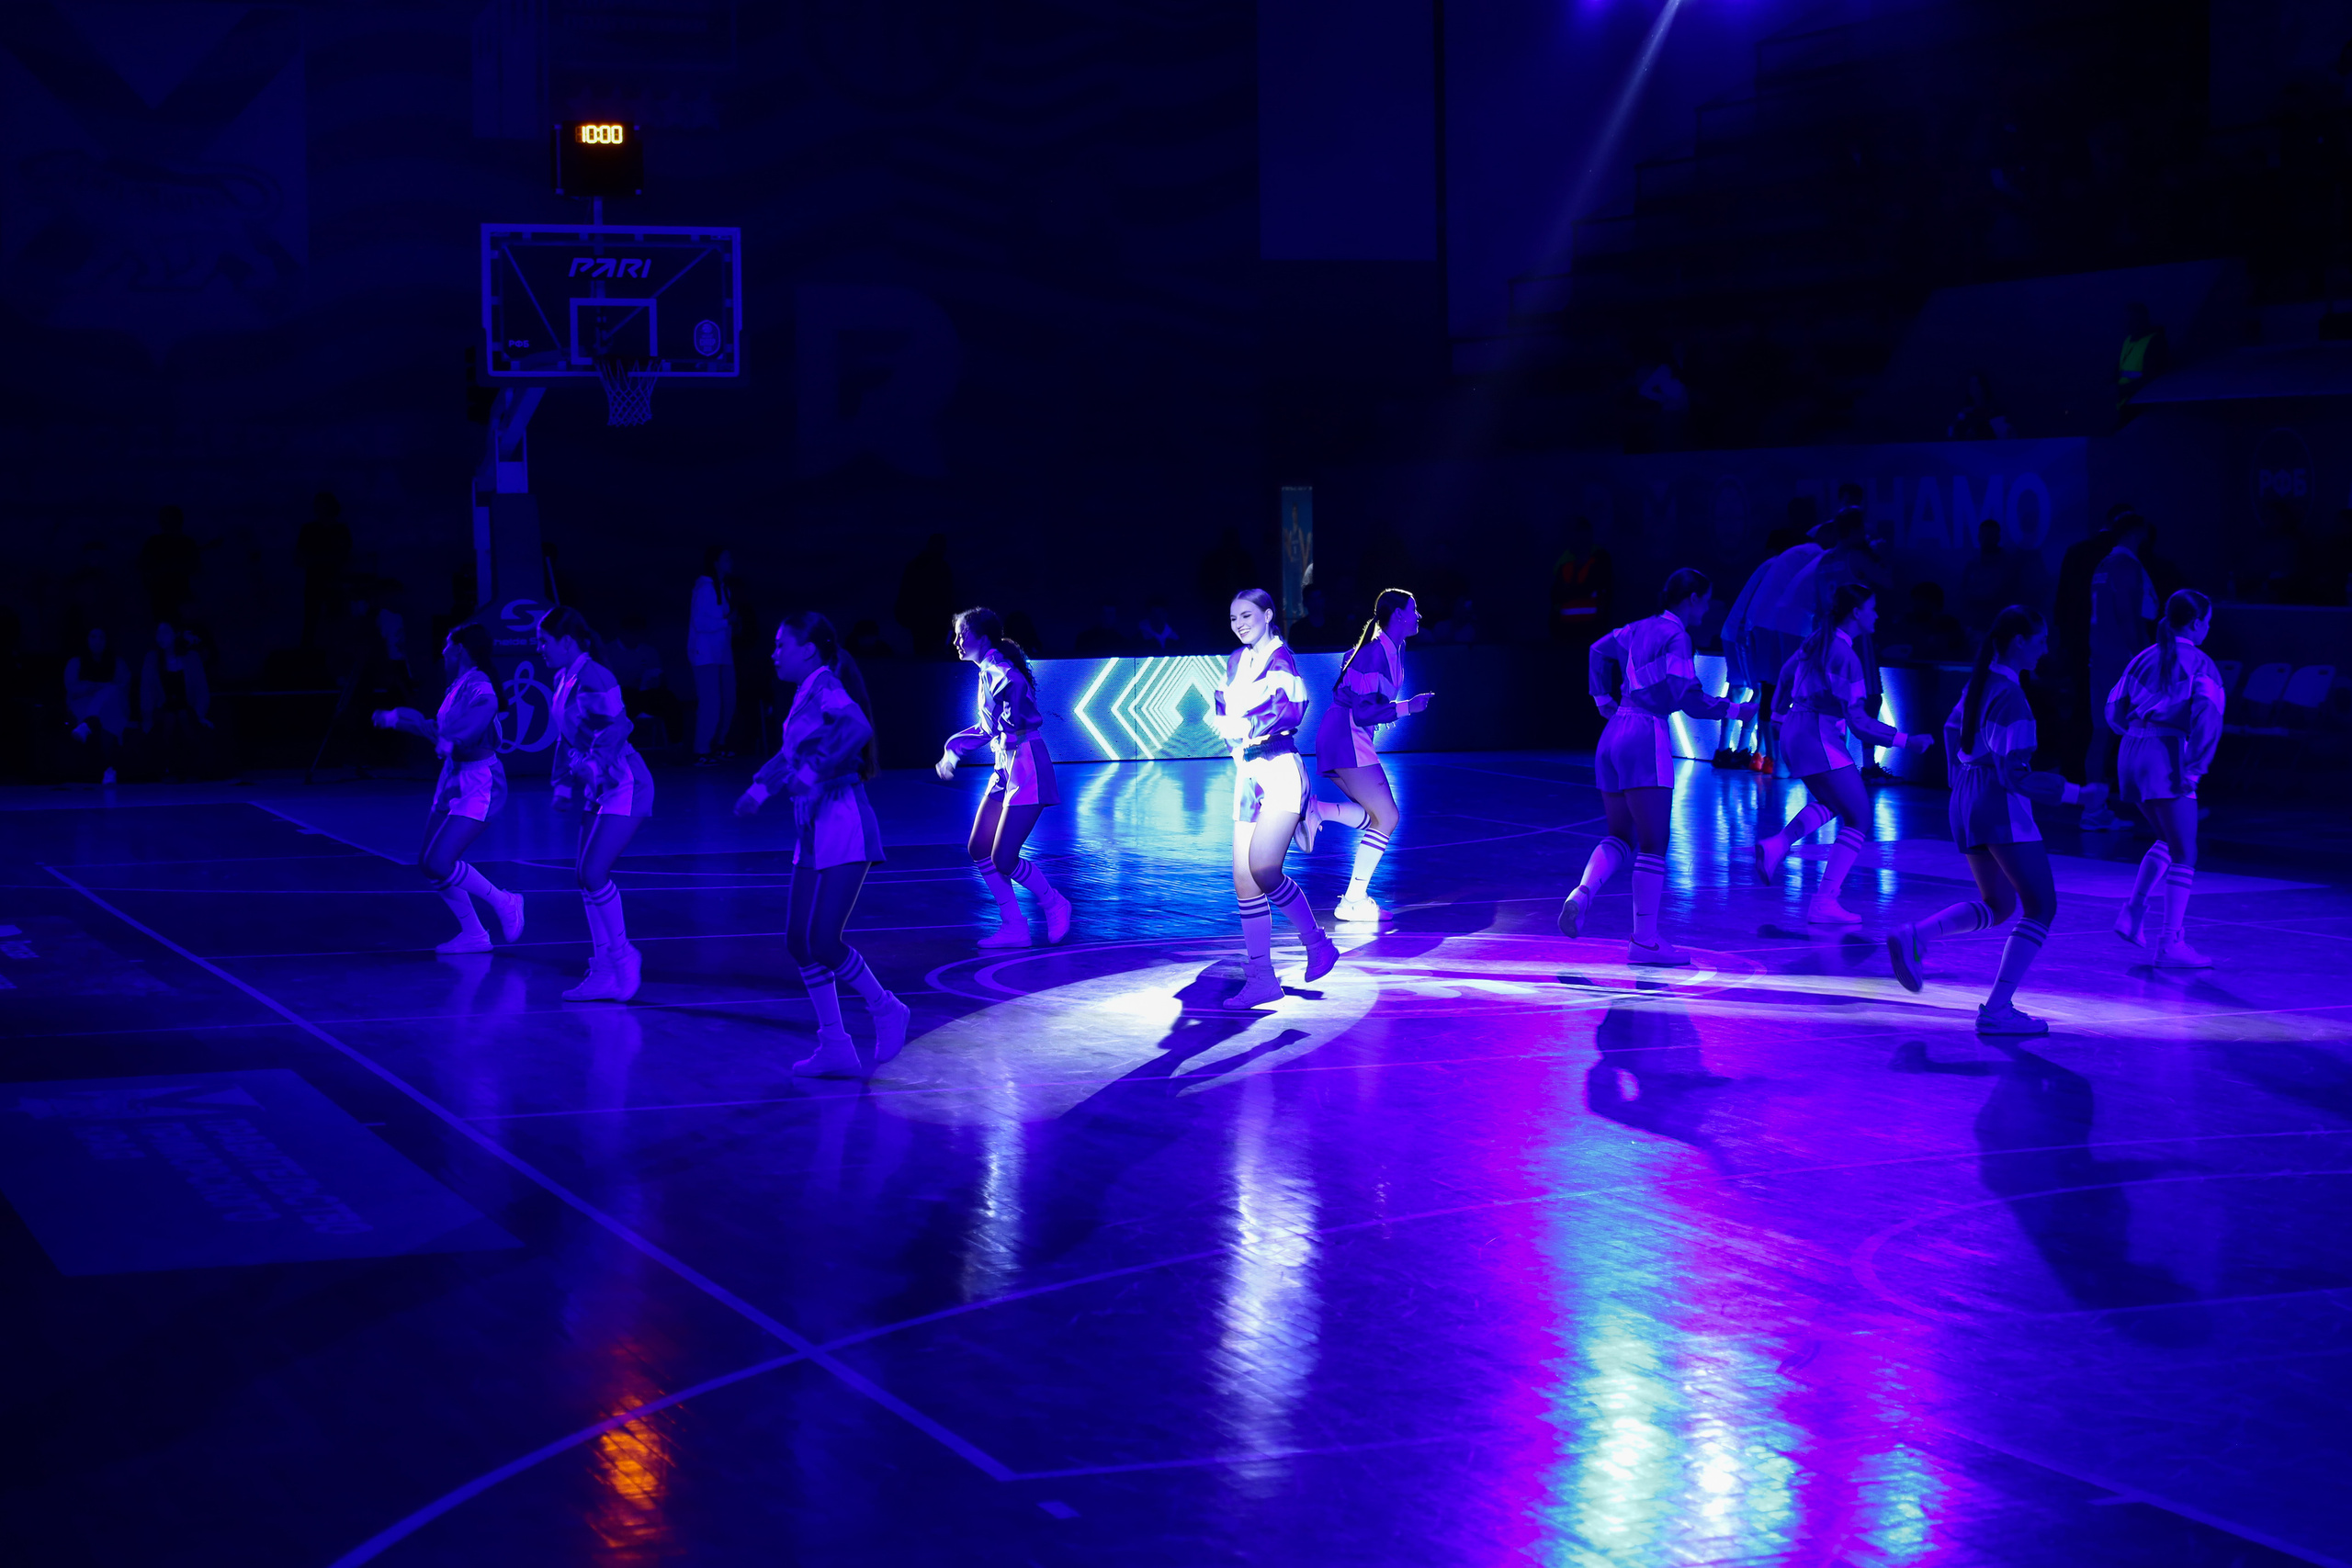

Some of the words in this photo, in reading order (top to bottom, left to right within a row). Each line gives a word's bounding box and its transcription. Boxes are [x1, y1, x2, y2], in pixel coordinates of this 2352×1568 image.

[582, 125, 623, 144] 10:00
[568, 256, 652, 278] PARI
[2258, 467, 2308, 498] РФБ
